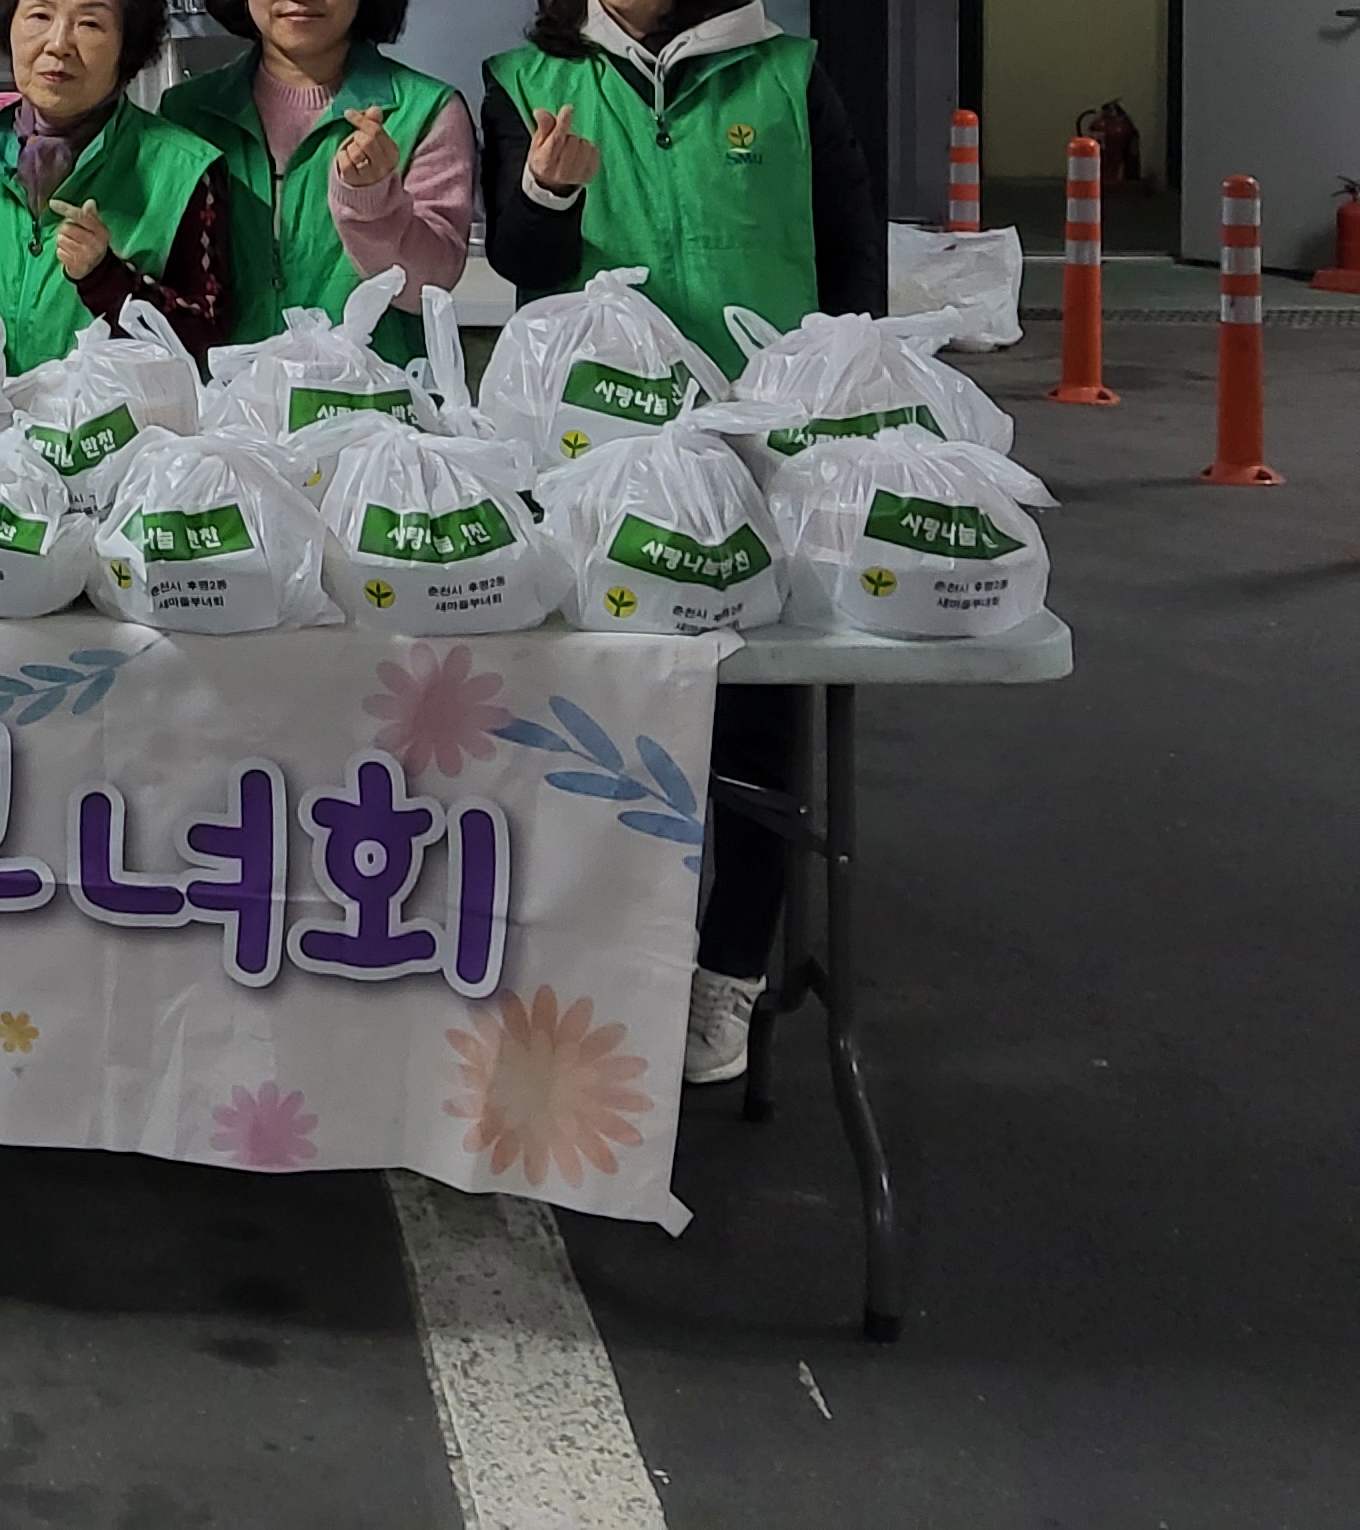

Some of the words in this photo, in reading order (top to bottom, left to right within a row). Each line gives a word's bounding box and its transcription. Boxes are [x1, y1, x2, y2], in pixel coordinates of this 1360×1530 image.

[80, 428, 116, 459] 반찬
[900, 512, 977, 547] 사랑나눔
[151, 581, 181, 597] 춘천시
[187, 580, 227, 591] 후평2동
[428, 584, 462, 597] 춘천시
[468, 576, 505, 592] 후평2동
[974, 579, 1009, 592] 후평2동
[159, 596, 224, 609] 새마을부녀회
[435, 593, 502, 612] 새마을부녀회
[937, 596, 1000, 610] 새마을부녀회
